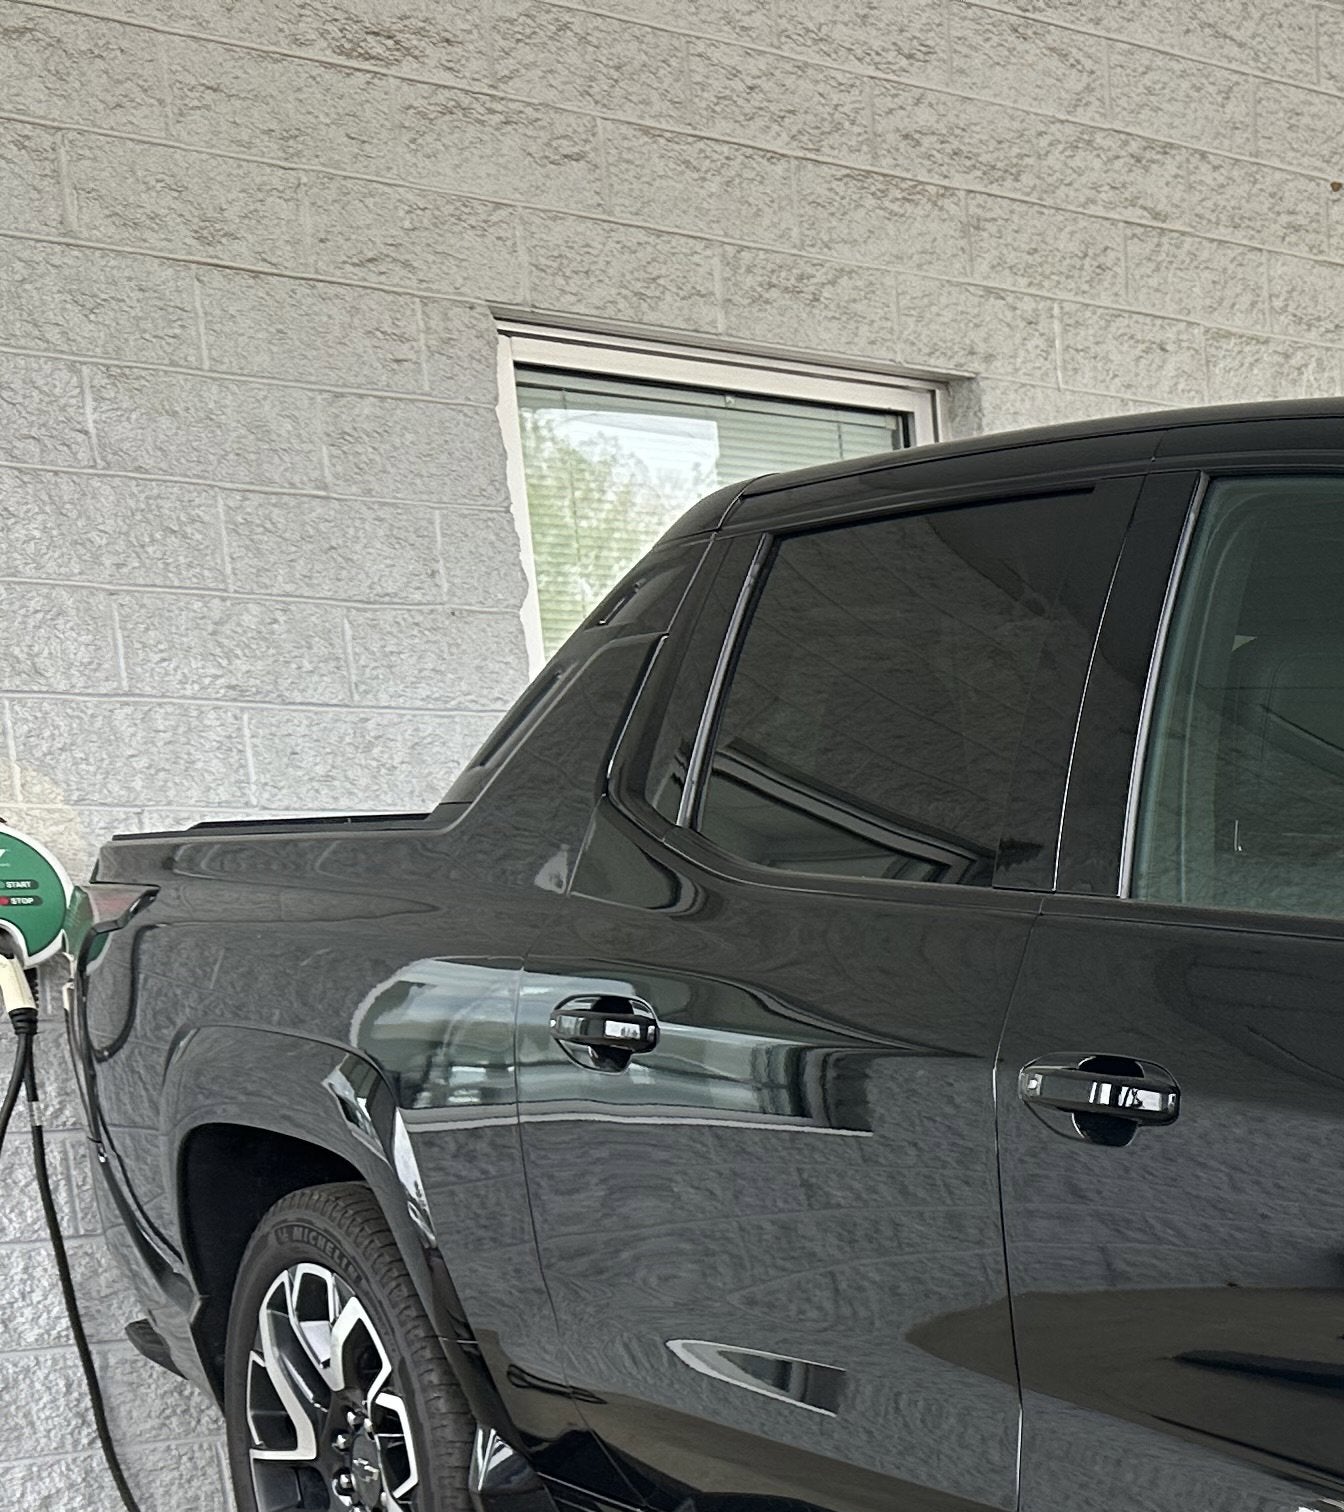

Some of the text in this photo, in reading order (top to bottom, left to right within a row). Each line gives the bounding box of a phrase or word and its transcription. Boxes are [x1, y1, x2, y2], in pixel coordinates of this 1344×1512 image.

[5, 881, 31, 889] START
[10, 897, 34, 905] STOP
[292, 1226, 358, 1281] MICHELIN
